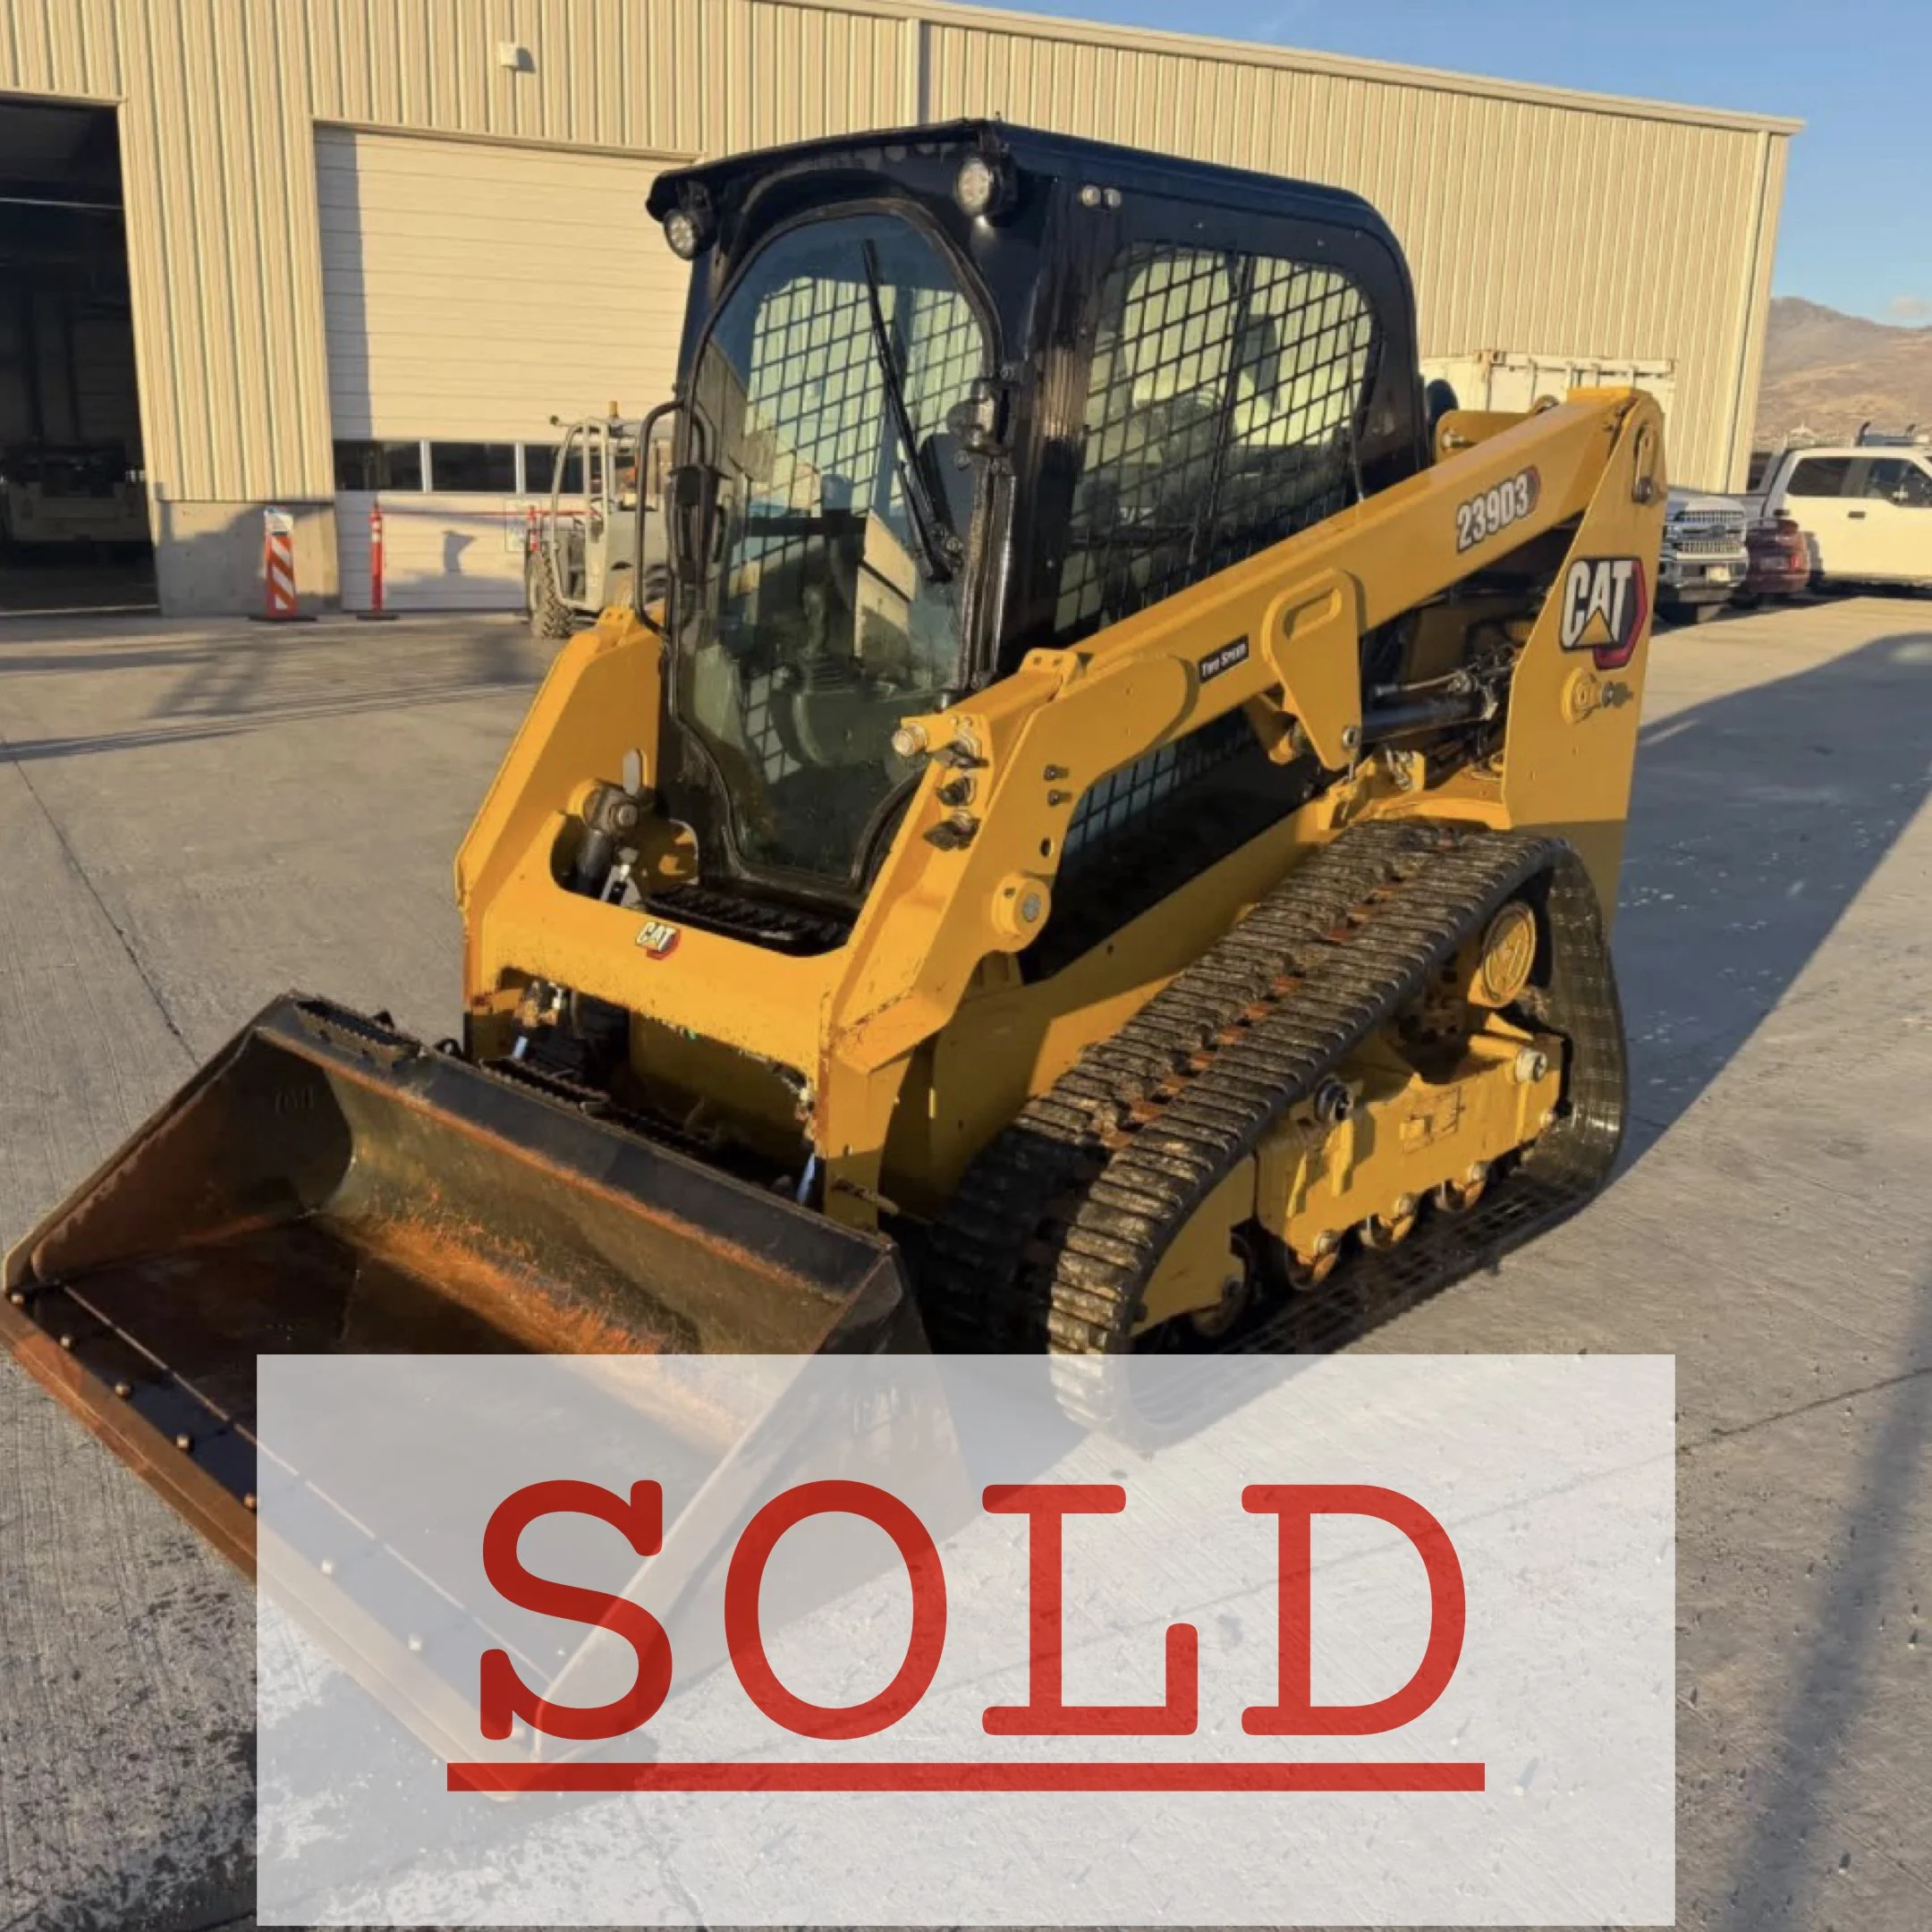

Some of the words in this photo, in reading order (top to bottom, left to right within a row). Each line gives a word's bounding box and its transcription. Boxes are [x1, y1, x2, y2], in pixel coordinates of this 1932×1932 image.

[1457, 474, 1530, 552] 239D3
[1562, 560, 1632, 648] CAT
[636, 921, 677, 953] CAT
